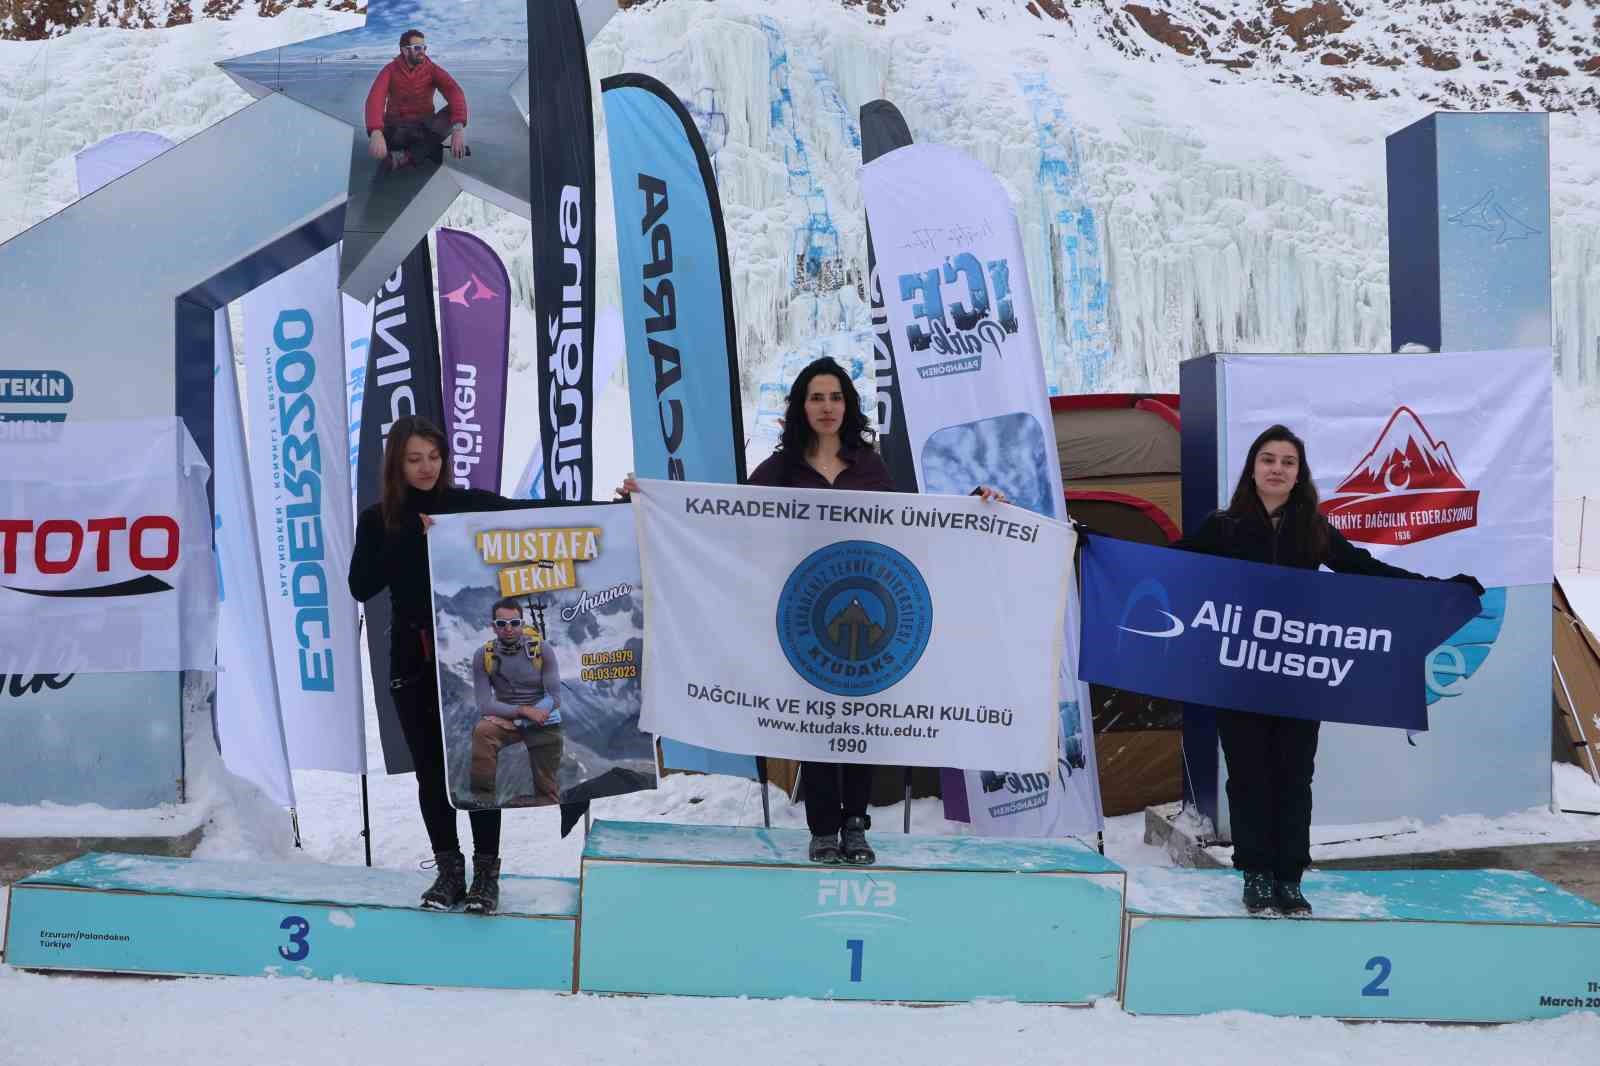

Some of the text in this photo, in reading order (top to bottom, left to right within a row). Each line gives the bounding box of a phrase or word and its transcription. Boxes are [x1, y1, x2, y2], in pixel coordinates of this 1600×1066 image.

[685, 496, 1039, 544] KARADENİZ TEKNİK ÜNİVERSİTESİ
[1327, 505, 1473, 529] ÜRKİYE DAĞCILIK FEDERASYONU
[0, 515, 180, 575] TOTO
[482, 530, 599, 561] MUSTAFA
[1190, 600, 1392, 653] Ali Osman
[808, 646, 896, 677] KTUDAKS
[1218, 636, 1354, 687] Ulusoy
[687, 683, 1012, 726] DAĞCILIK VE KIŞ SPORLARI KULÜBÜ
[757, 715, 940, 739] www.ktudaks.ktu.edu.tr
[827, 737, 867, 754] 1990
[278, 916, 311, 961] 3
[846, 939, 864, 982] 1
[1361, 955, 1392, 997] 2
[1539, 996, 1583, 1007] March
